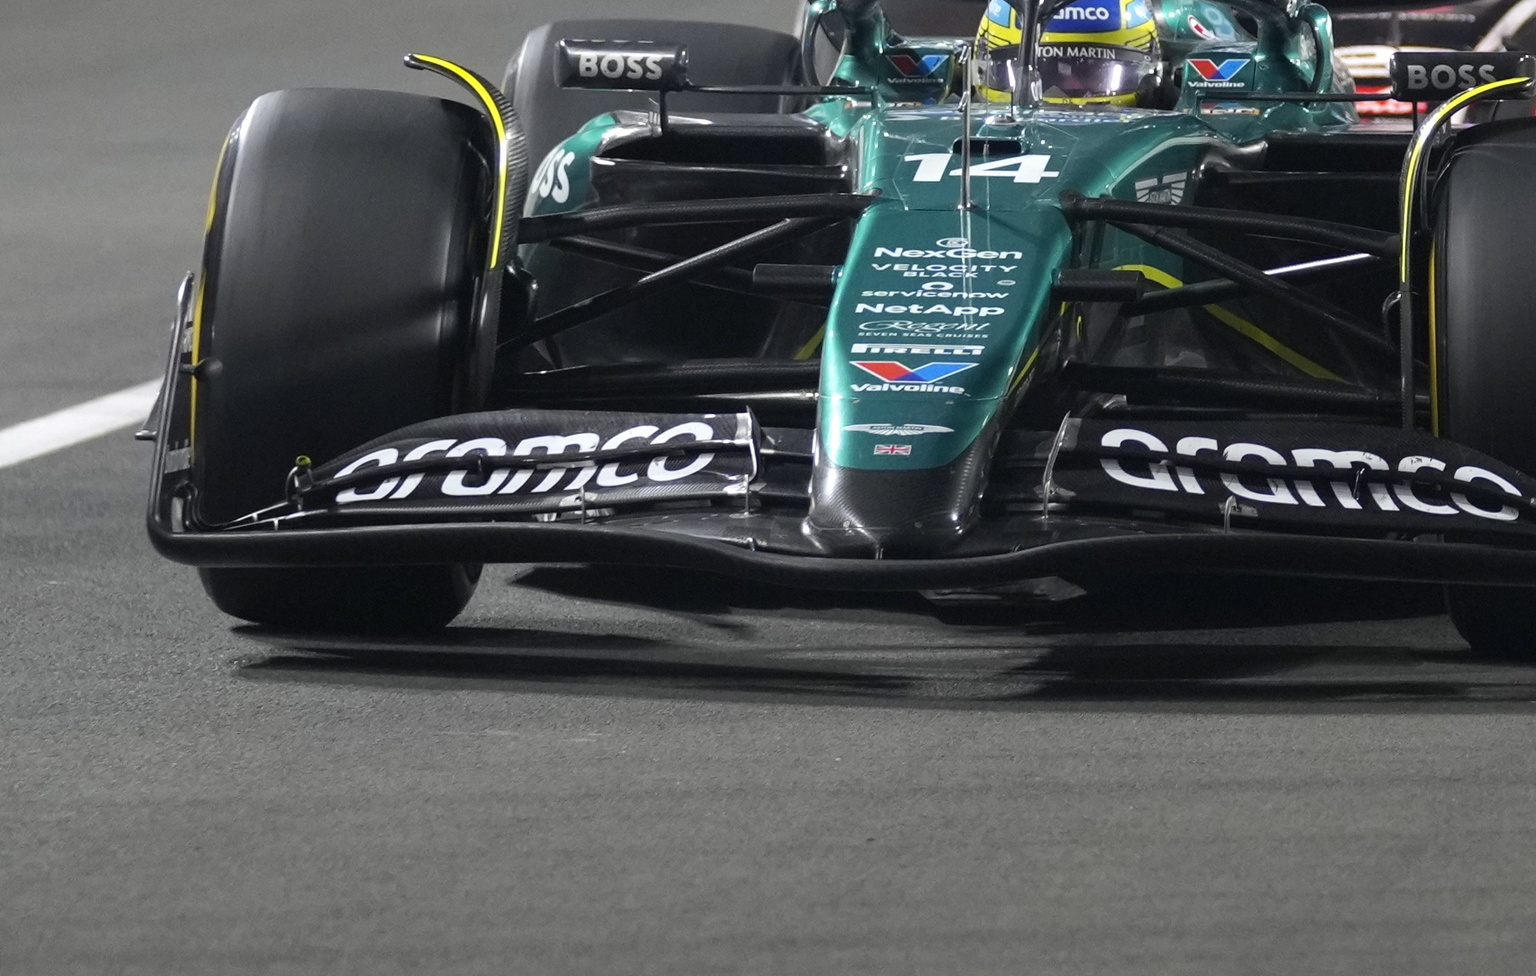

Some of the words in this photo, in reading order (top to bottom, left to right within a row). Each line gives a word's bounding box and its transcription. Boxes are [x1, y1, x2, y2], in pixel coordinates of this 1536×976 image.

[1066, 45, 1116, 60] MARTIN
[578, 54, 663, 80] BOSS
[887, 76, 945, 84] Valvoline
[1187, 80, 1246, 88] Valvoline
[1407, 63, 1496, 91] BOSS
[904, 153, 1061, 184] 14
[873, 246, 1024, 260] NexGen
[871, 263, 1019, 273] VELOCITY
[902, 271, 979, 279] BLACK
[861, 289, 1009, 299] servicenow
[854, 303, 1006, 317] NetApp
[850, 343, 986, 356] PIRELLI
[849, 383, 967, 395] Valvoline
[334, 421, 716, 504] aramco
[1099, 427, 1523, 522] aramco
